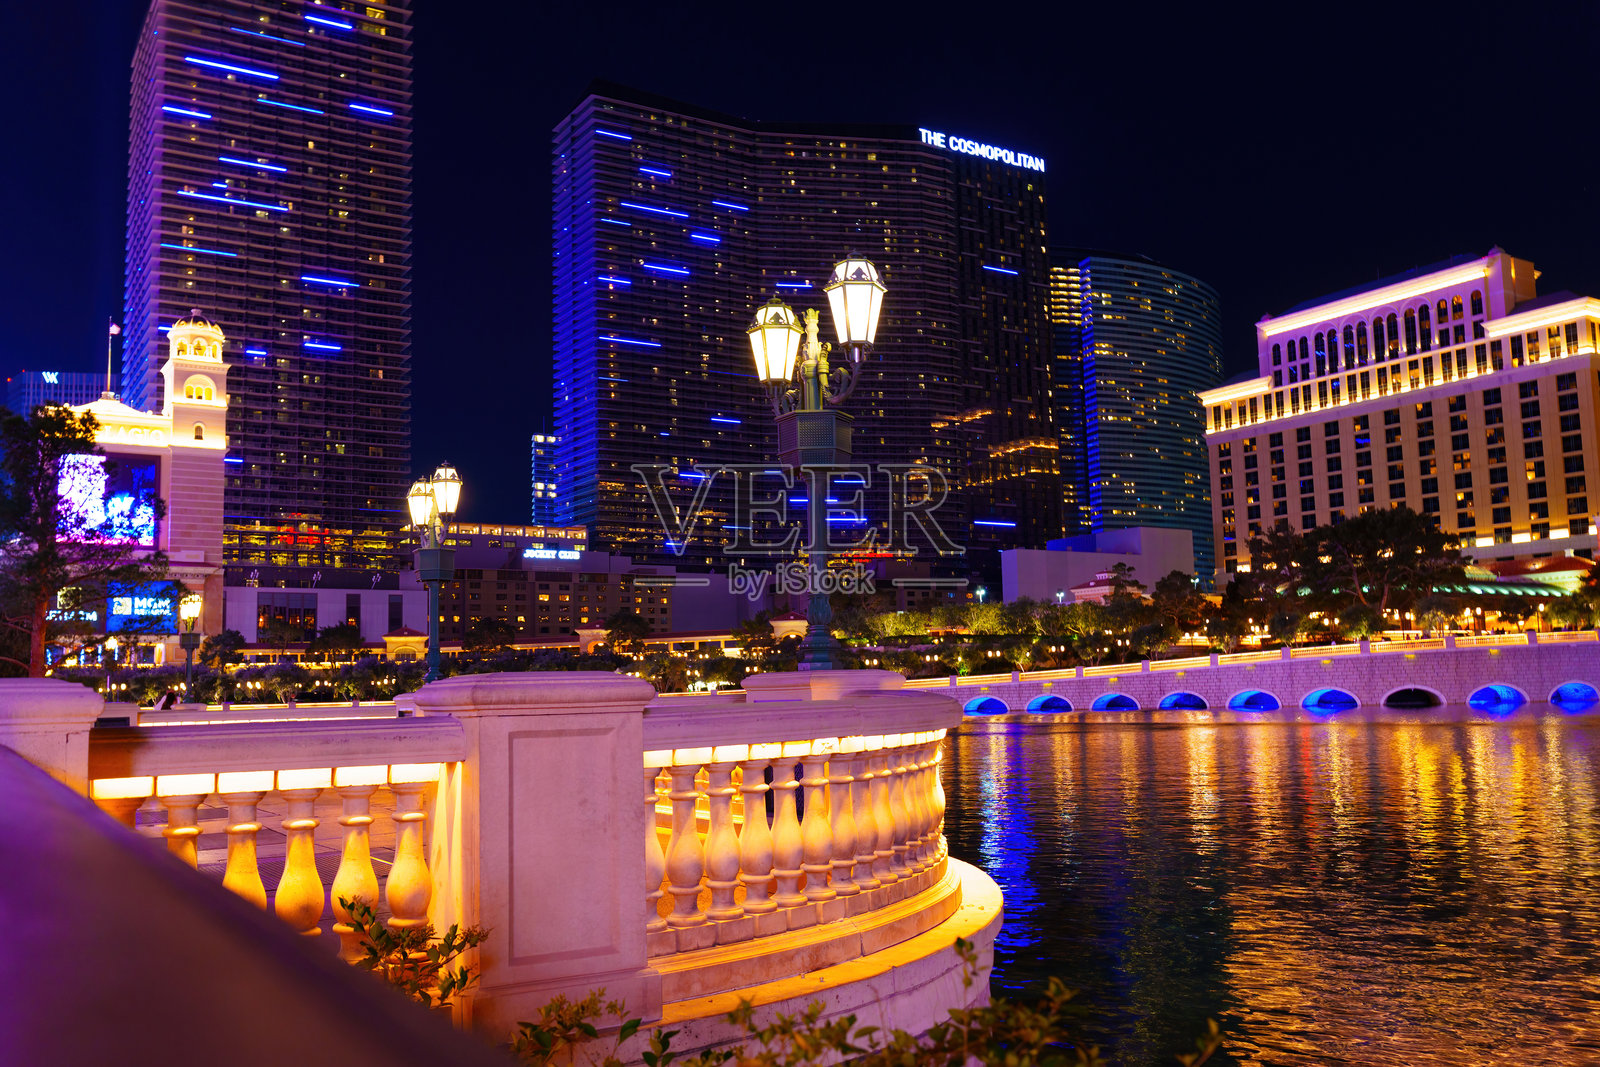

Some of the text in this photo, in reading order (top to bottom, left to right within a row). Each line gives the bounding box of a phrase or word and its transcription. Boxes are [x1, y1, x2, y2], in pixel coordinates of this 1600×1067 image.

[918, 127, 1046, 173] THE COSMOPOLITAN
[523, 548, 581, 560] JOCKEY CLUB
